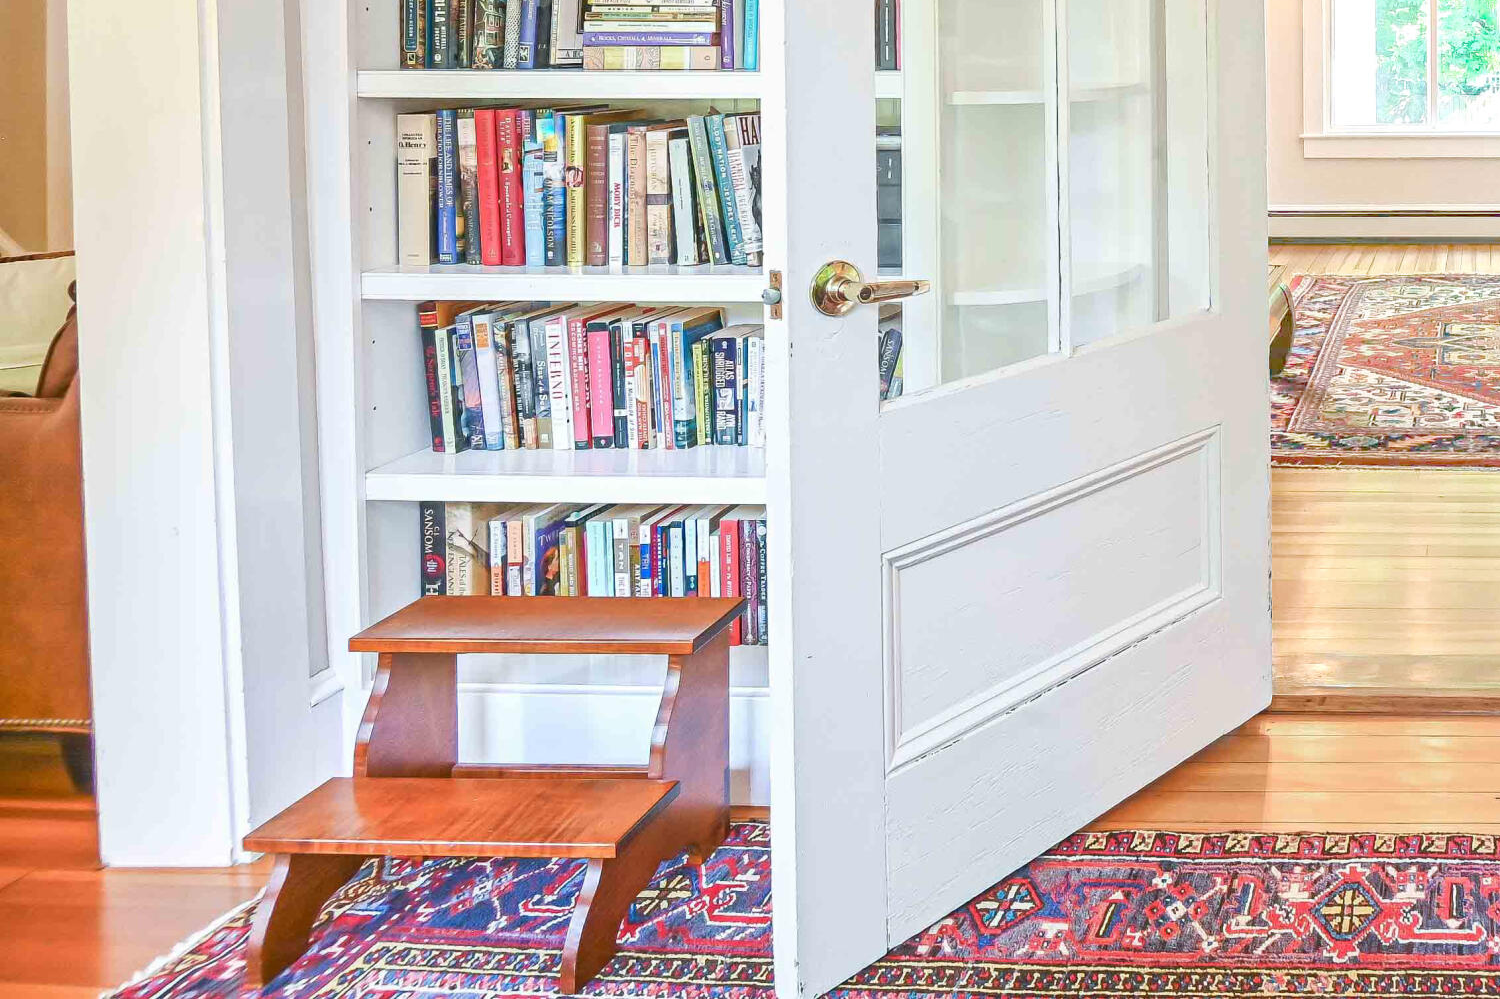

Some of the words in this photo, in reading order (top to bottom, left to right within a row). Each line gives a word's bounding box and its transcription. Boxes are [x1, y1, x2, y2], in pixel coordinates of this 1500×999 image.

[444, 117, 452, 133] THE
[630, 136, 639, 156] The
[713, 126, 723, 146] LOST
[717, 149, 725, 178] NATION
[628, 159, 638, 205] Diagnosis
[445, 196, 452, 207] OF
[613, 182, 621, 208] MOBY
[724, 187, 734, 221] JEFFREY
[613, 209, 621, 228] DICK
[536, 360, 546, 379] Star
[715, 351, 725, 388] SHRUGGED
[724, 359, 733, 380] ATLAS
[717, 411, 726, 430] RAND
[725, 413, 735, 428] AYN
[424, 509, 434, 554] SANSOM
[458, 555, 467, 578] TALES
